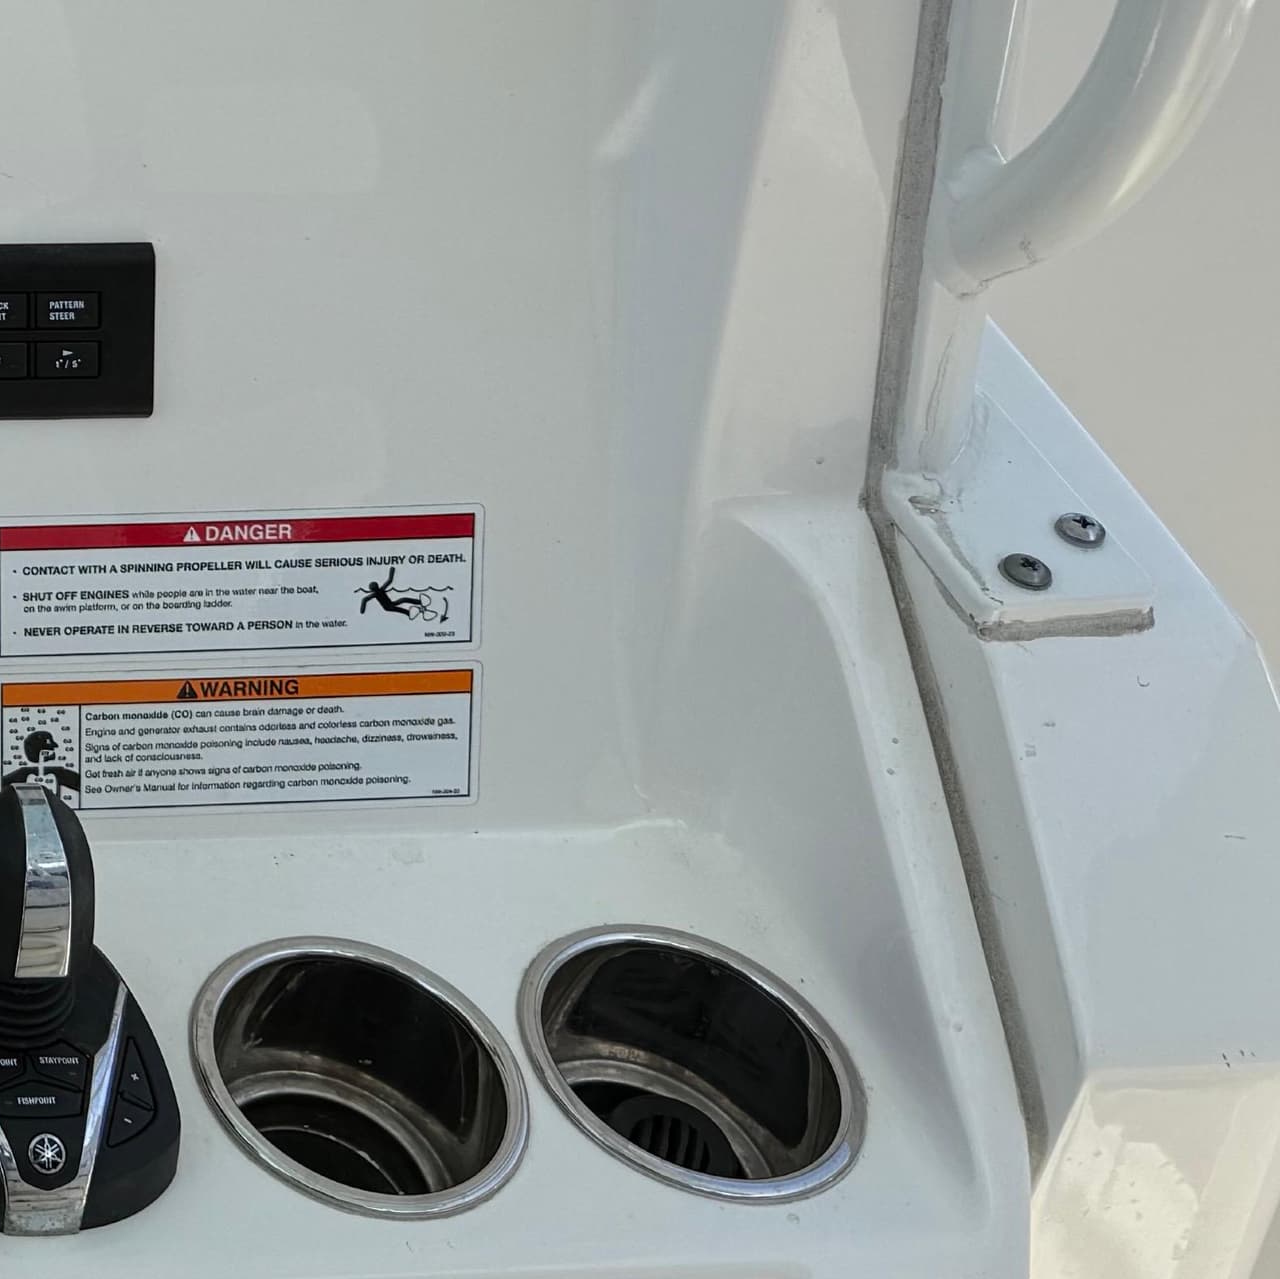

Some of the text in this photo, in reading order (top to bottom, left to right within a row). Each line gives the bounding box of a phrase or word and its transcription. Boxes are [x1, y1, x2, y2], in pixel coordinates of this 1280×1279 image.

[49, 300, 84, 310] PATTERN
[49, 312, 75, 321] STEER
[205, 524, 292, 542] DANGER
[23, 553, 466, 576] CONTACT WITH A SPINNING PROPELLER WILL CAUSE SERIOUS INJURY OR DEATH.
[23, 590, 129, 601] SHUT OFF ENGINES
[24, 620, 292, 637] NEVER OPERATE IN REVERSE TOWARD A PERSON
[200, 680, 299, 697] WARNING
[85, 710, 193, 720] Carbon monoxide (CO)
